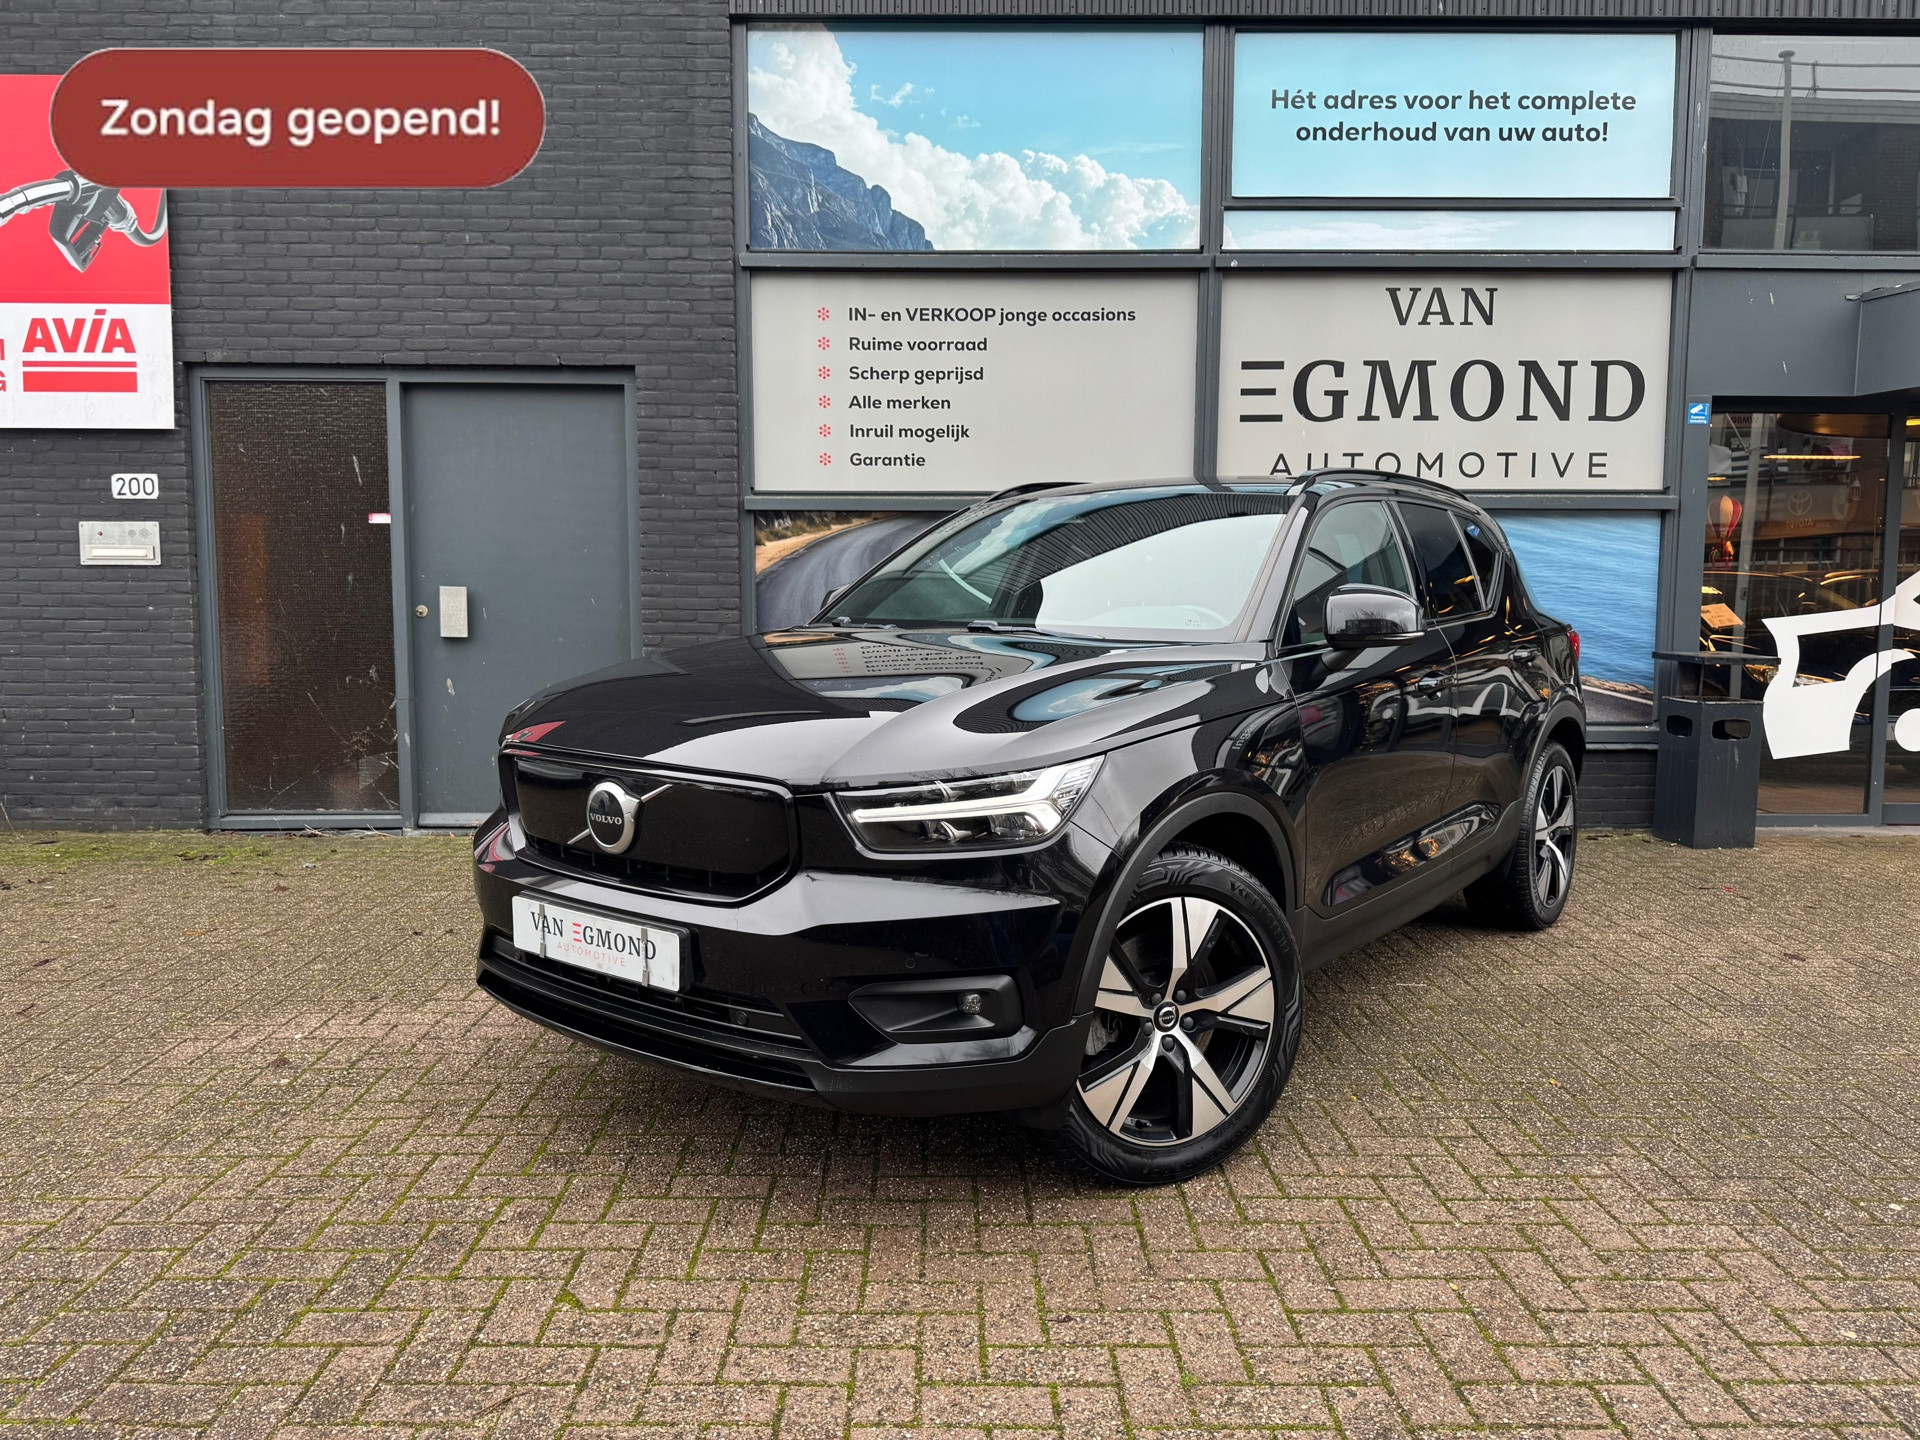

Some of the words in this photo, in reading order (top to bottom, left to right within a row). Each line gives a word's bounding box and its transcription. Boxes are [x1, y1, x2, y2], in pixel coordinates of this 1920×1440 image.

[1272, 89, 1317, 110] Hét
[1323, 89, 1397, 110] adres
[1404, 95, 1463, 110] voor
[1469, 89, 1511, 110] het
[1517, 90, 1636, 116] complete
[1296, 121, 1437, 142] onderhoud
[1443, 127, 1491, 142] van
[1498, 127, 1536, 142] uw
[1541, 122, 1608, 142] auto!
[1386, 287, 1498, 326] VAN
[849, 308, 876, 322] IN-
[880, 312, 902, 322] en
[906, 308, 996, 322] VERKOOP
[998, 308, 1048, 327] jonge
[1051, 308, 1136, 322] occasions
[849, 337, 903, 351] Ruime
[906, 337, 988, 352] voorraad
[849, 366, 910, 384] Scherp
[914, 366, 984, 386] geprijsd
[1240, 360, 1645, 423] EGMOND
[849, 395, 882, 409] Alle
[886, 395, 951, 410] merken
[850, 424, 894, 438] Inruil
[898, 424, 970, 443] mogelijk
[850, 453, 926, 467] Garantie
[1269, 452, 1608, 479] AUTOMOTIVE
[116, 477, 155, 496] 200
[590, 813, 622, 825] VOLVO
[530, 911, 564, 938] VAN
[573, 922, 657, 960] EGMOND
[557, 941, 626, 967] AUTOMOTIVE
